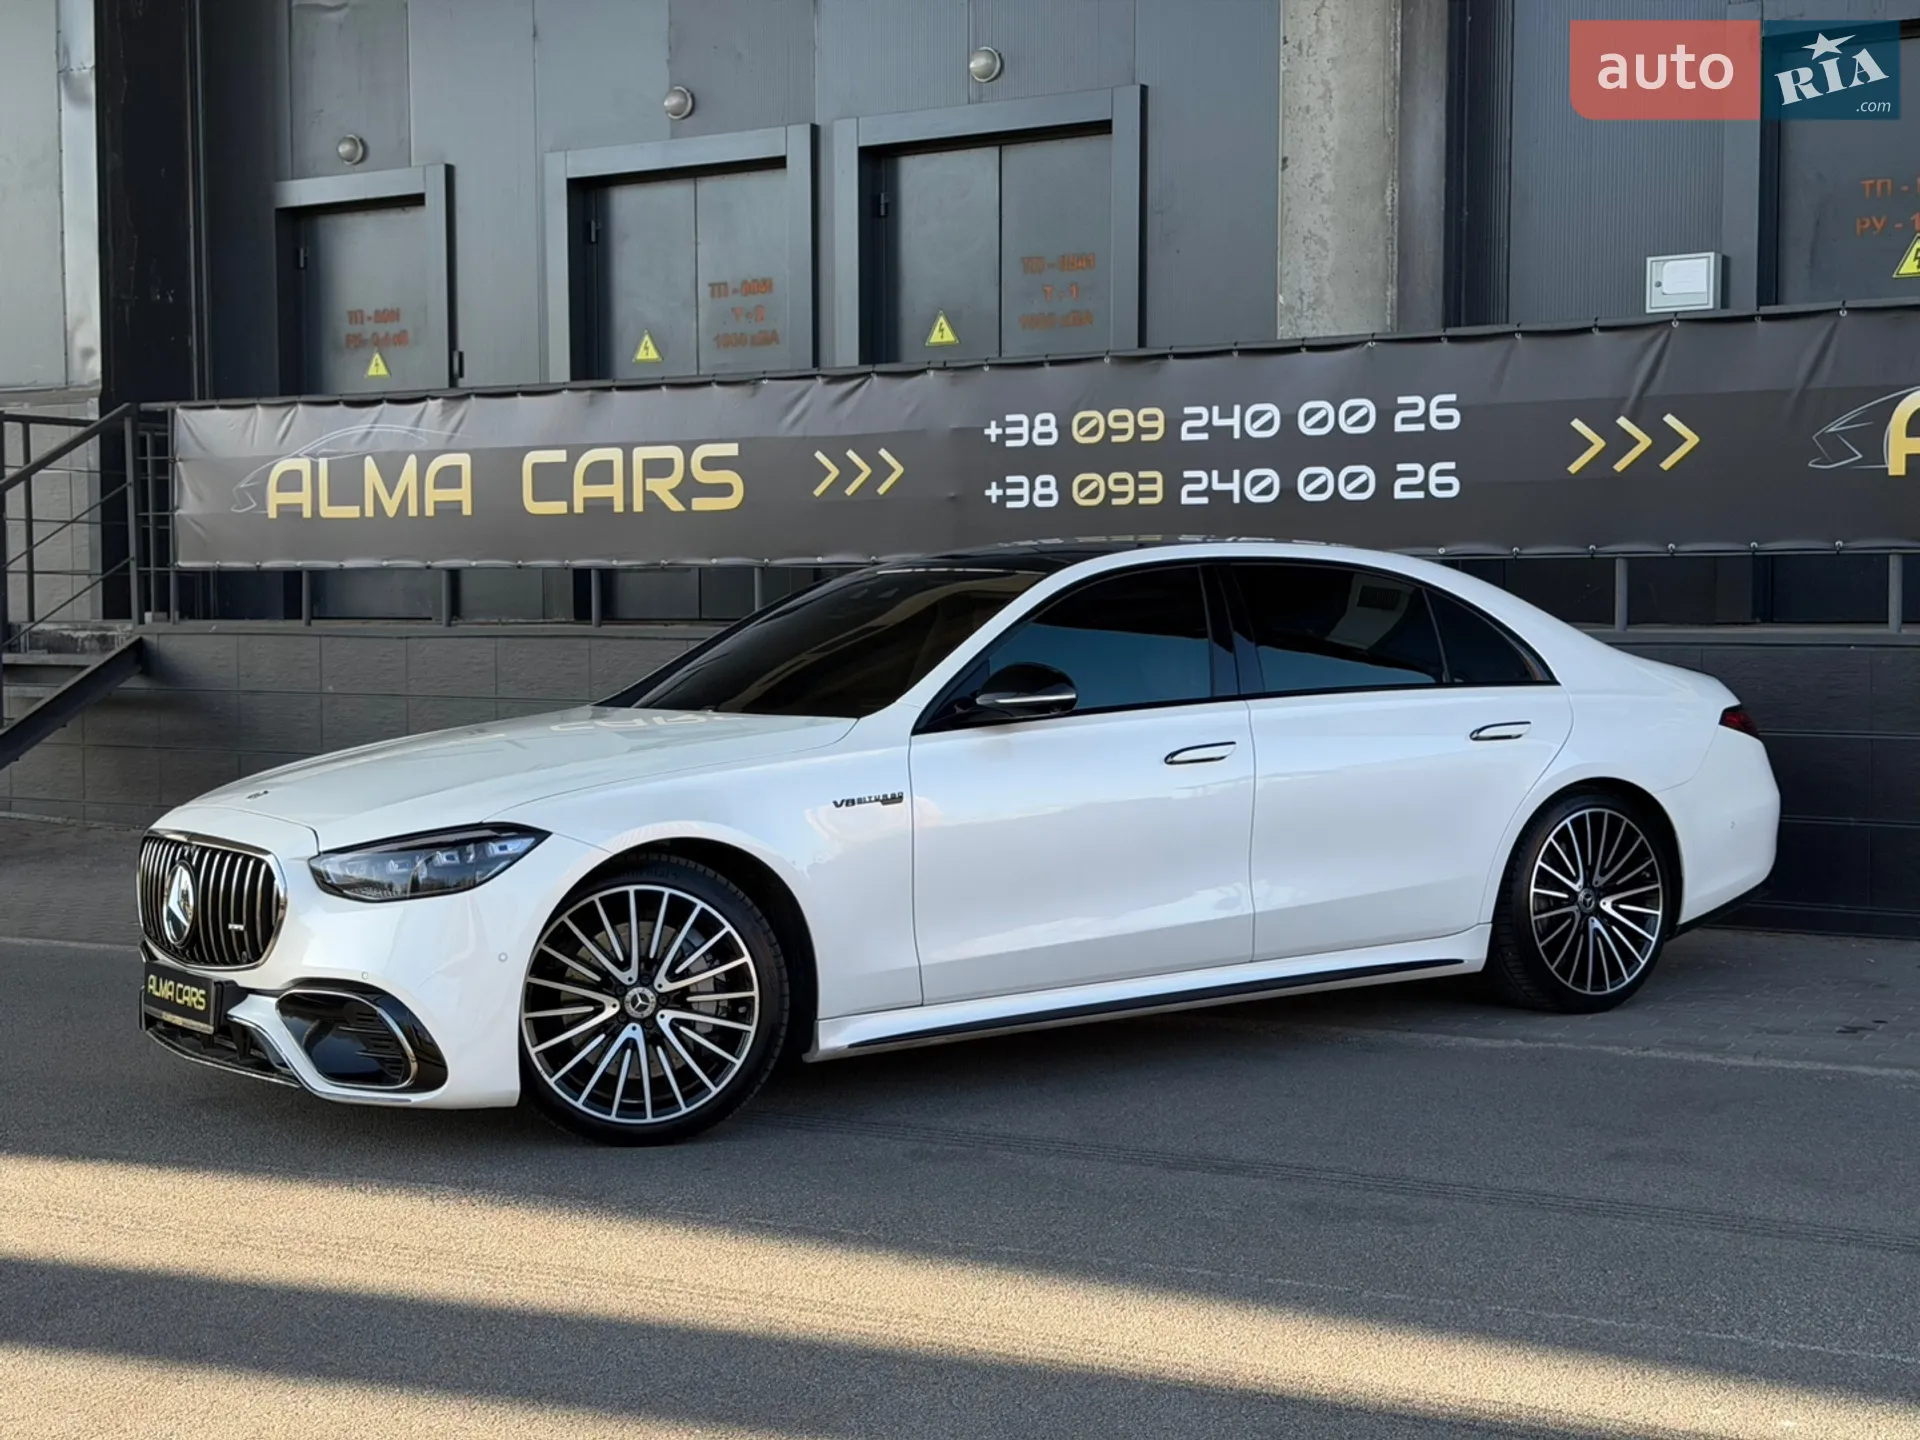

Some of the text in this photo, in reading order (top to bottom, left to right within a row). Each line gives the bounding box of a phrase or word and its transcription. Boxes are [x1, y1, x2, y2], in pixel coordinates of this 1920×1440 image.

[984, 393, 1462, 447] +38 099 240 00 26
[267, 443, 745, 519] ALMA CARS
[984, 461, 1462, 509] +38 093 240 00 26
[148, 975, 206, 1010] ALMA CARS
